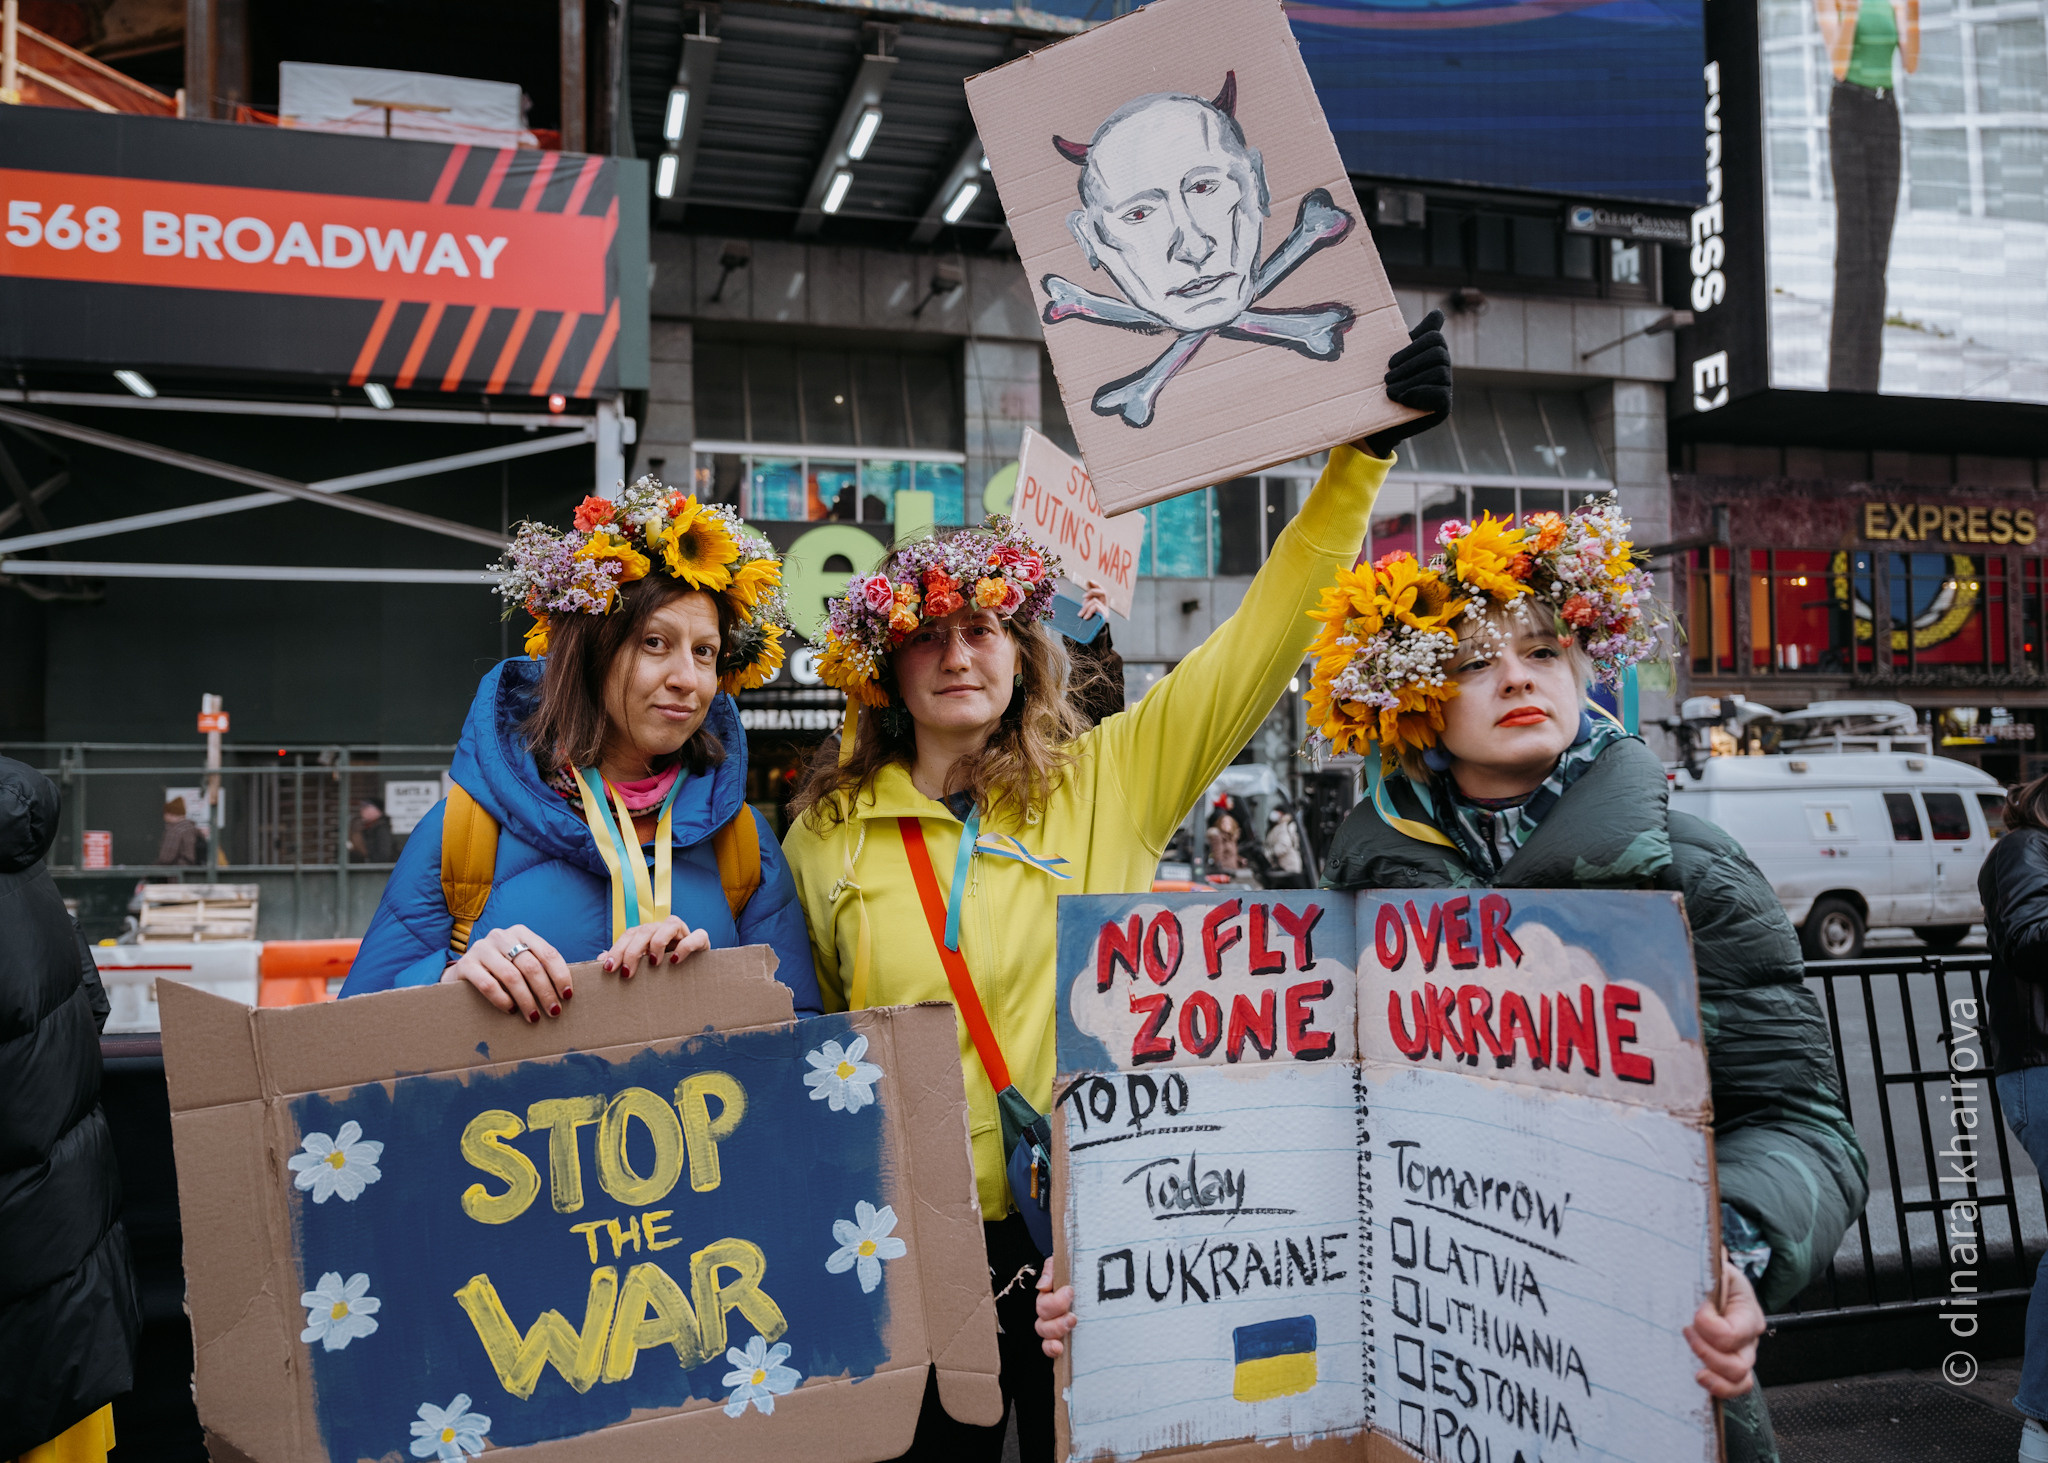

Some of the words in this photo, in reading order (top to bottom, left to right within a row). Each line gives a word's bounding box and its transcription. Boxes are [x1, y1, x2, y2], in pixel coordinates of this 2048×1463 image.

[5, 200, 121, 253] 568
[142, 210, 509, 280] BROADWAY
[1022, 476, 1094, 562] PUTIN'S
[1098, 533, 1132, 590] WAR
[1067, 465, 1100, 517] STO
[1864, 502, 2038, 545] EXPRESS
[1097, 908, 1186, 993] NO
[1200, 897, 1326, 979] FLY
[1373, 893, 1524, 972] OVER
[1128, 979, 1336, 1064] ZONE
[1388, 981, 1655, 1085] UKRAINE
[461, 1071, 749, 1225] STOP
[1123, 1149, 1246, 1228] Today
[1387, 1140, 1572, 1239] Tomorrow
[570, 1209, 683, 1265] THE
[1146, 1231, 1349, 1305] UKRAINE
[1423, 1226, 1547, 1316] LATVIA
[453, 1237, 789, 1402] WAR
[1426, 1284, 1592, 1397] LITHUANIA
[1431, 1348, 1579, 1450] ESTONIA
